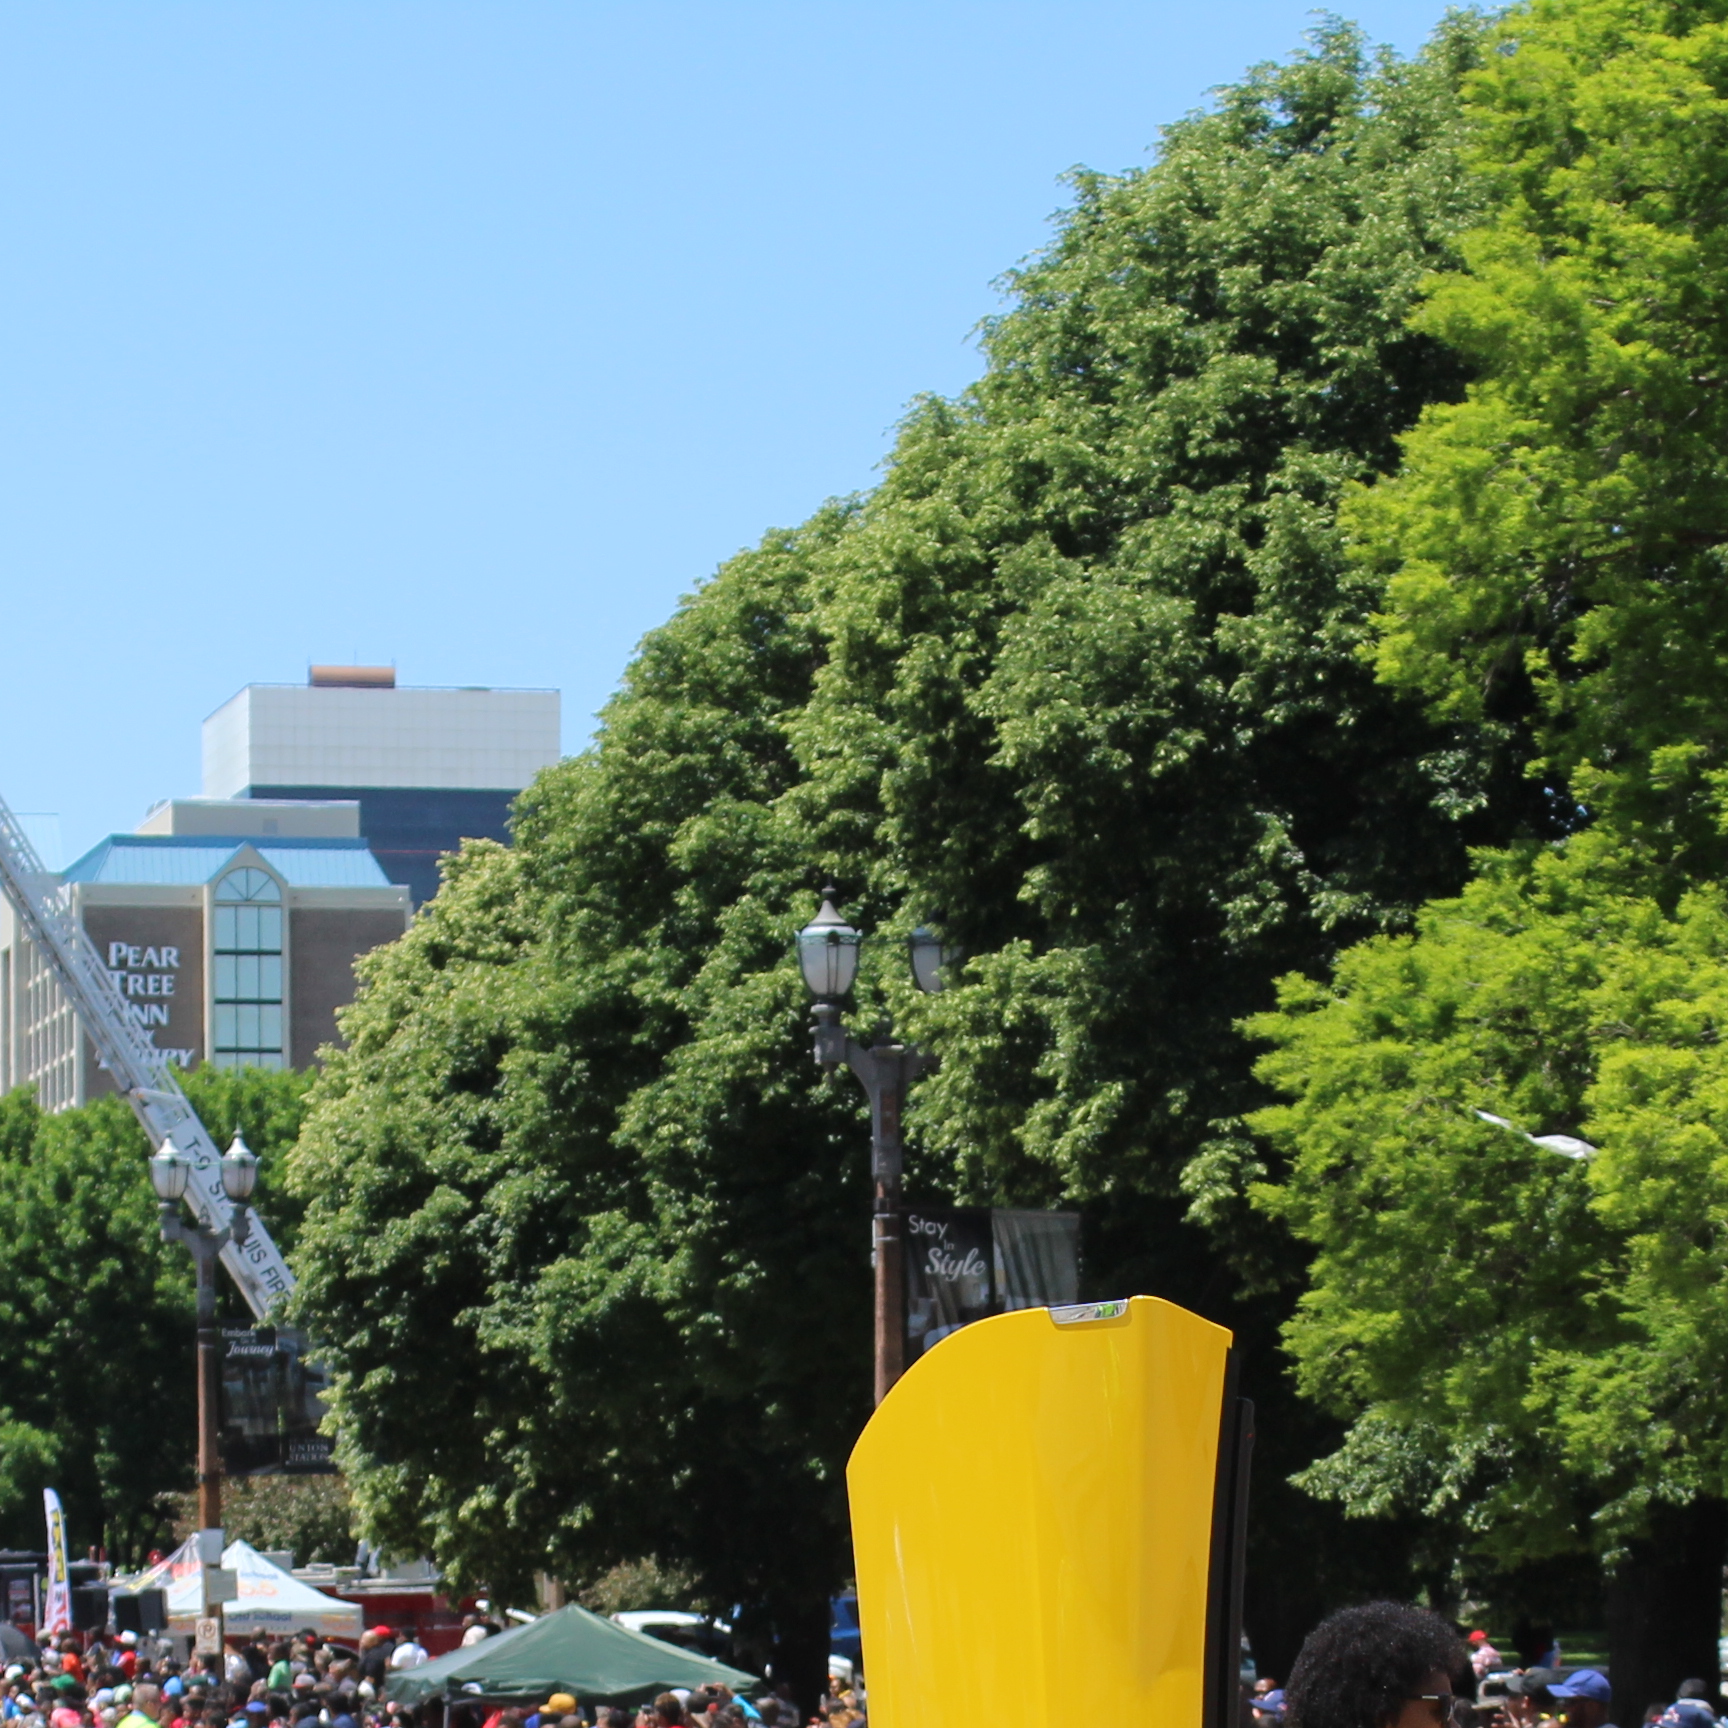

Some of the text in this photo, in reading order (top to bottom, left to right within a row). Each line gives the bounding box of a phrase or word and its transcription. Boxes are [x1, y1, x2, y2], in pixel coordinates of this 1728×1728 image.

[108, 941, 179, 968] PEAR
[908, 1214, 949, 1239] Stay
[925, 1247, 986, 1281] Style
[225, 1340, 274, 1358] Journey
